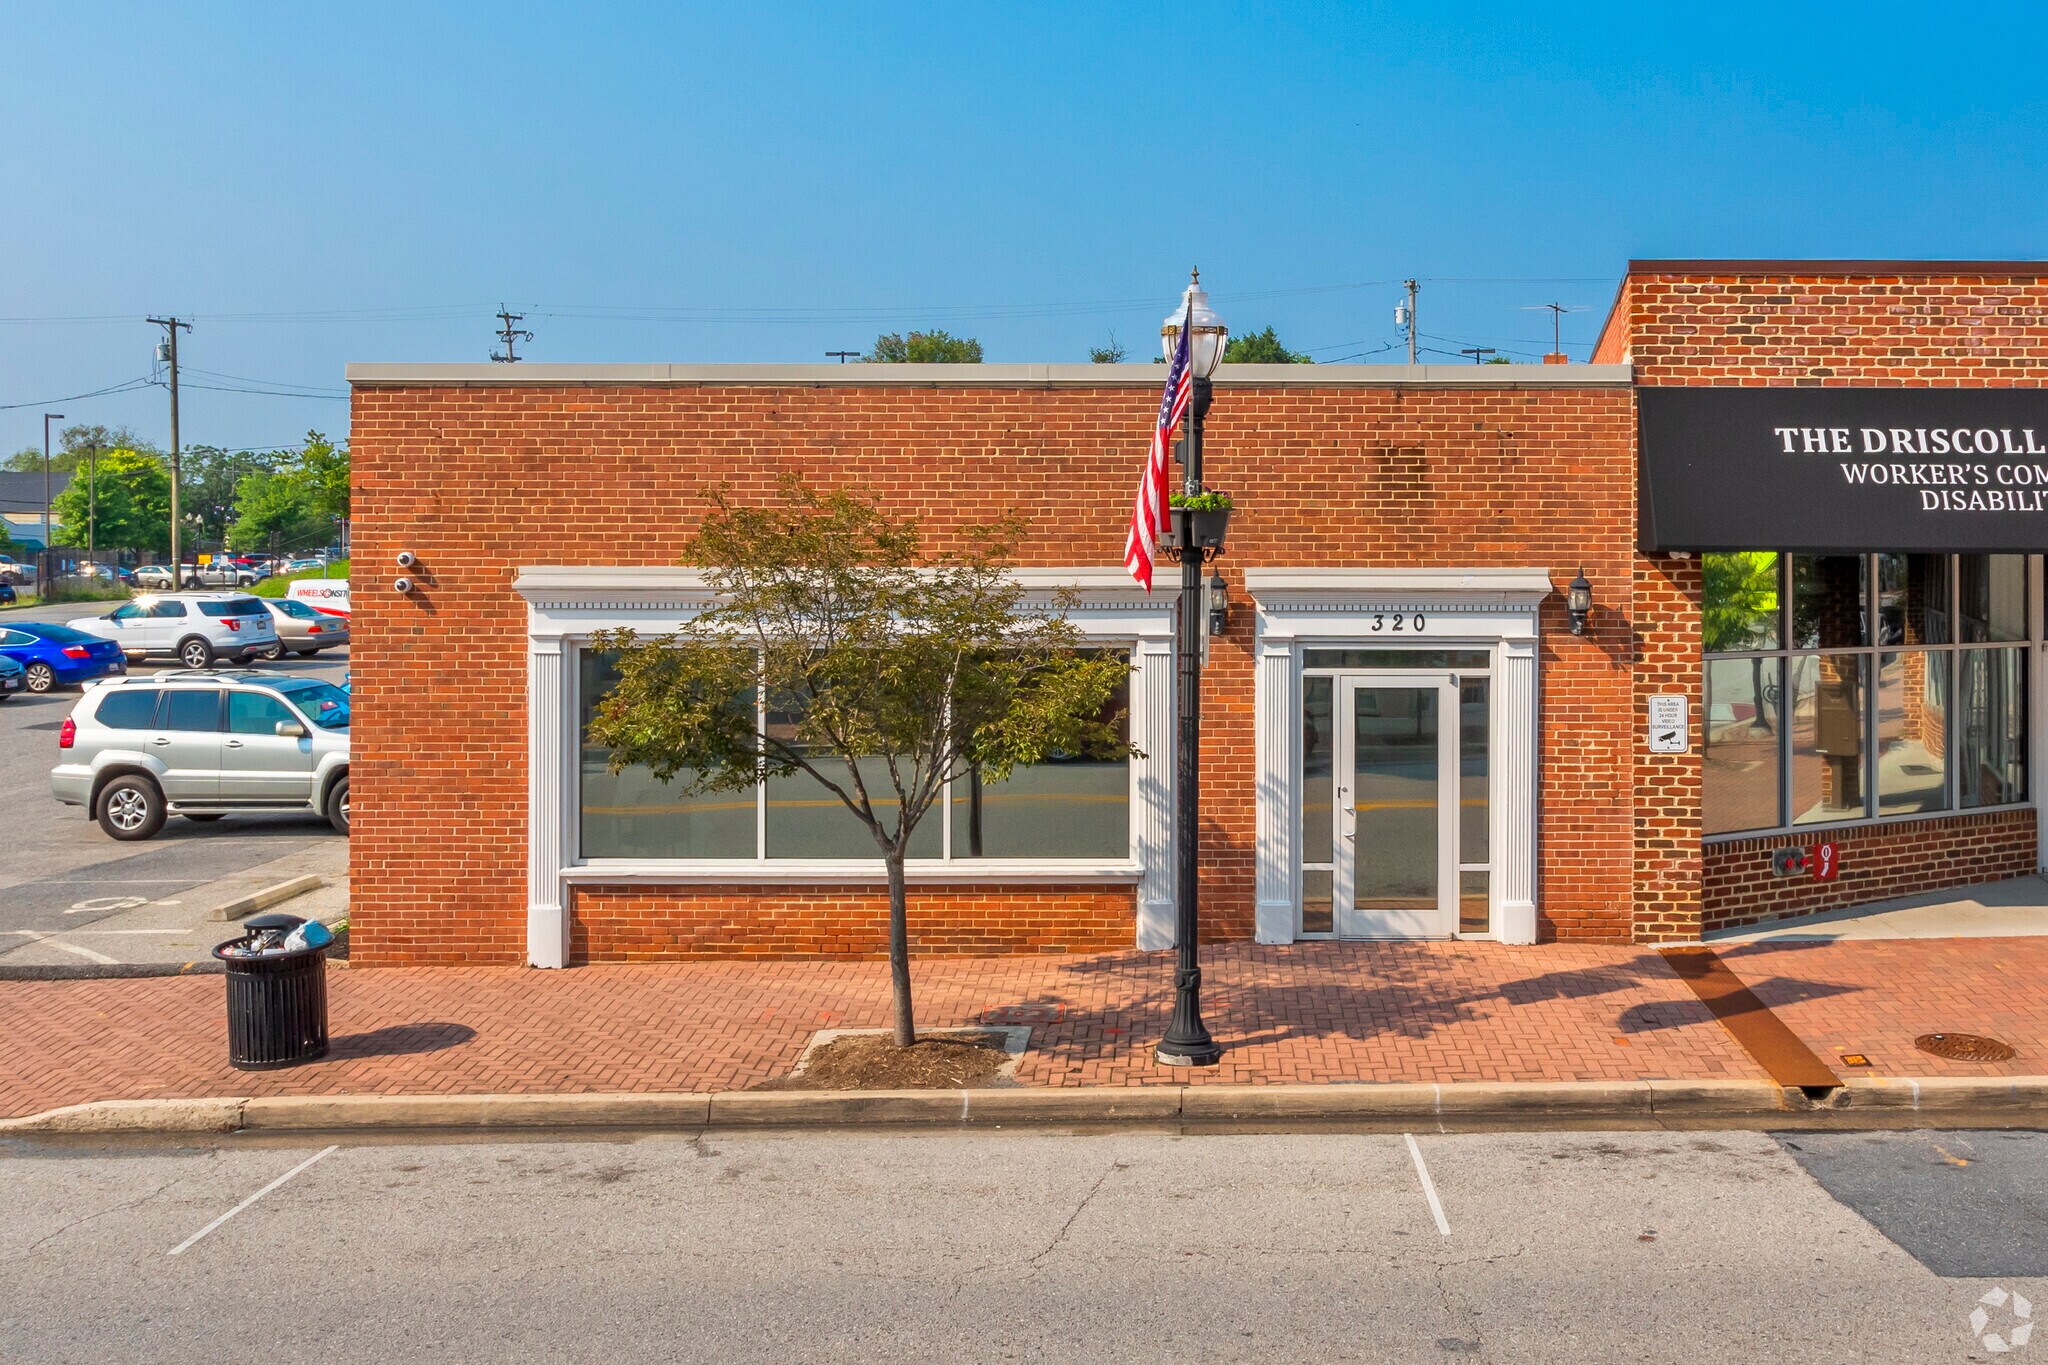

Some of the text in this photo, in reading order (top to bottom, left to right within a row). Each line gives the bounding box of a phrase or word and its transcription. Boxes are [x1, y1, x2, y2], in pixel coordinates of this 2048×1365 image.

[1774, 428, 2046, 454] THE DRISCOLL
[1840, 463, 1989, 485] WORKER'S
[1371, 613, 1425, 632] 320
